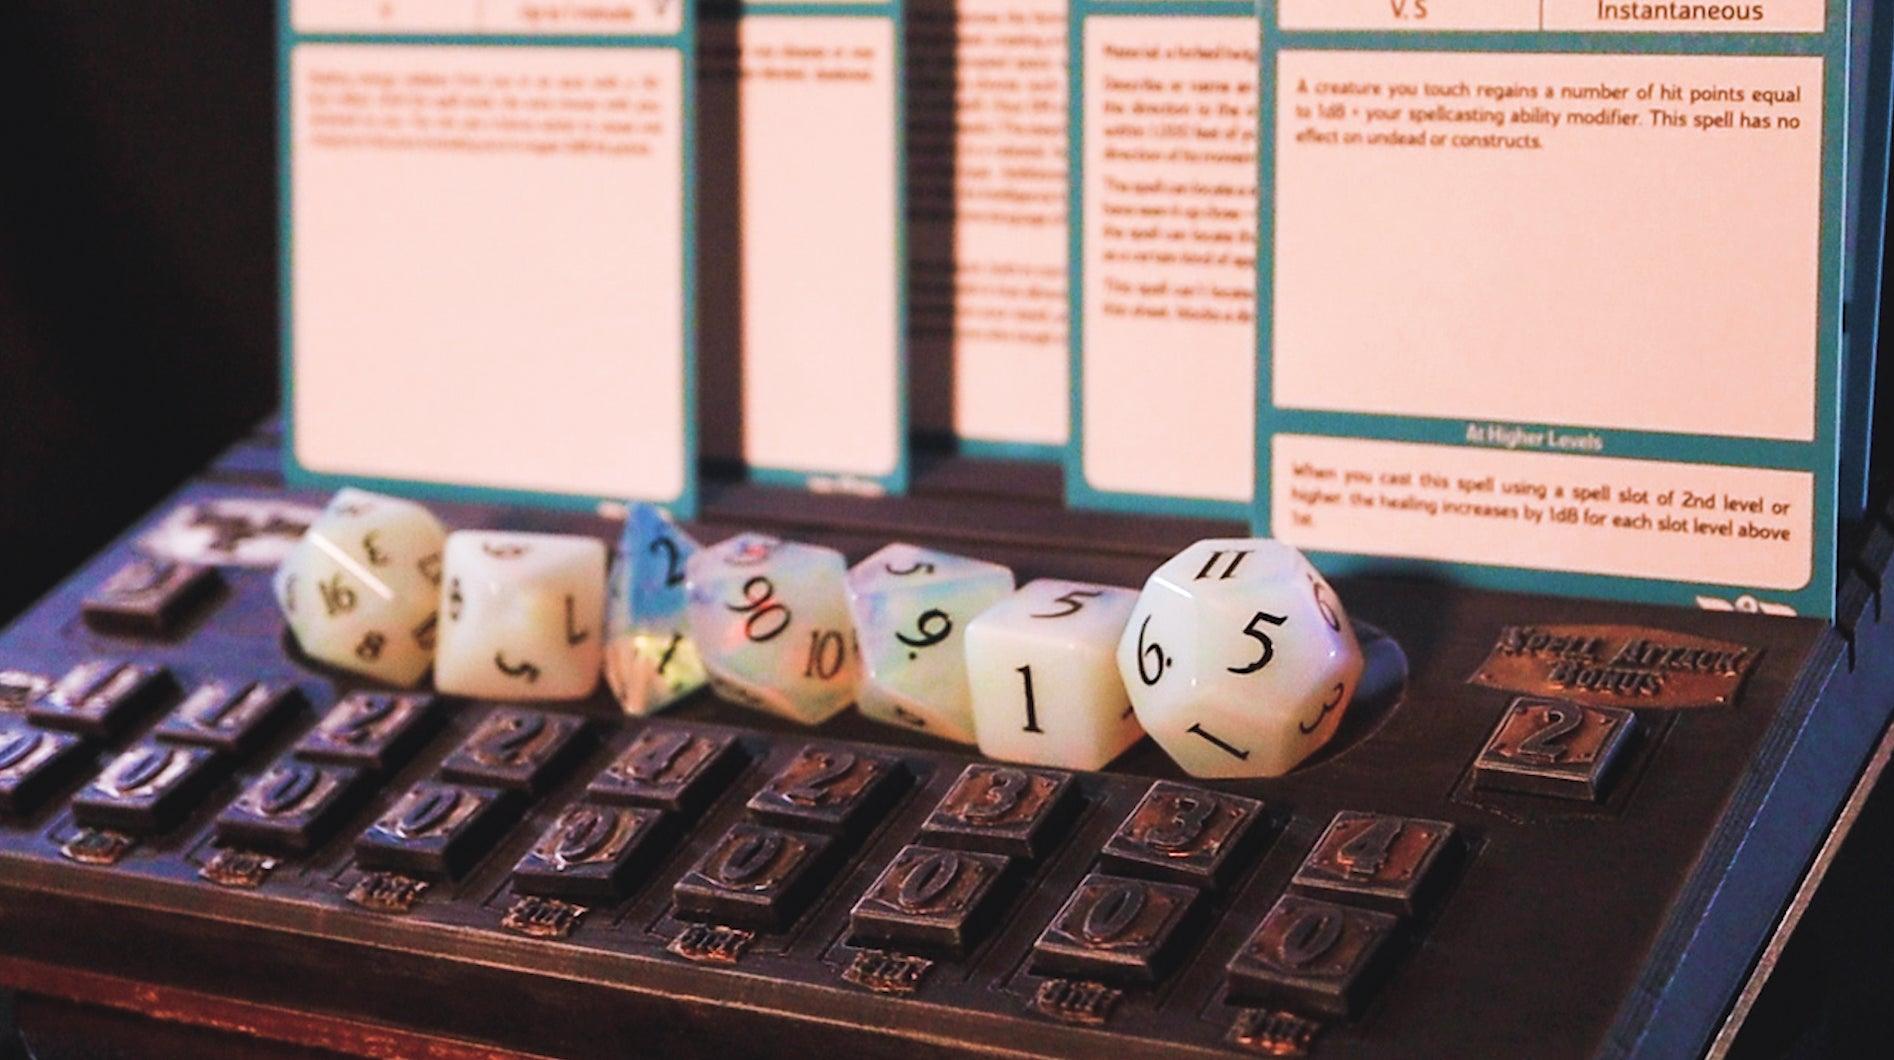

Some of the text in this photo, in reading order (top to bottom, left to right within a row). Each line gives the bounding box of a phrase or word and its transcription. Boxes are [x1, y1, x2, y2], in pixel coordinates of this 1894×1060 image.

[1597, 0, 1764, 21] Instantaneous
[1296, 79, 1802, 106] A creature you touch regains a number of hit points equal
[1366, 107, 1402, 123] your
[1409, 104, 1505, 126] spellcasting
[1511, 106, 1560, 127] ability
[1651, 109, 1687, 127] This
[1694, 111, 1733, 130] spell
[1740, 112, 1771, 129] has
[1777, 115, 1800, 129] no
[1296, 127, 1338, 144] effect
[1367, 130, 1426, 147] undead
[1430, 133, 1445, 147] or
[1380, 493, 1437, 516] healing
[1443, 499, 1519, 520] increases
[1524, 504, 1543, 524] by
[1584, 507, 1607, 527] for
[1613, 511, 1651, 531] each
[1658, 514, 1688, 533] slot
[1694, 517, 1733, 537] level
[1738, 521, 1791, 542] above
[1420, 472, 1449, 488] this
[1457, 476, 1494, 494] spell
[1501, 480, 1547, 500] using
[1554, 486, 1564, 499] a
[1573, 484, 1611, 504] spell
[1619, 486, 1648, 505] slot
[1657, 490, 1675, 507] of
[1682, 491, 1715, 510] 2nd
[1724, 494, 1763, 514] level
[1772, 502, 1790, 515] or
[649, 536, 685, 588] 2
[726, 575, 792, 643] 90
[805, 628, 845, 681] 10
[1227, 610, 1289, 675] 5
[1015, 664, 1044, 734] 1
[1187, 723, 1250, 760] 1
[1517, 698, 1585, 764] 2
[788, 750, 856, 800] 2
[962, 767, 1029, 820] 3
[1144, 793, 1217, 847] 3
[719, 831, 785, 883] 0
[898, 850, 960, 911] 0
[1083, 881, 1147, 940] 0
[1283, 906, 1344, 966] 0
